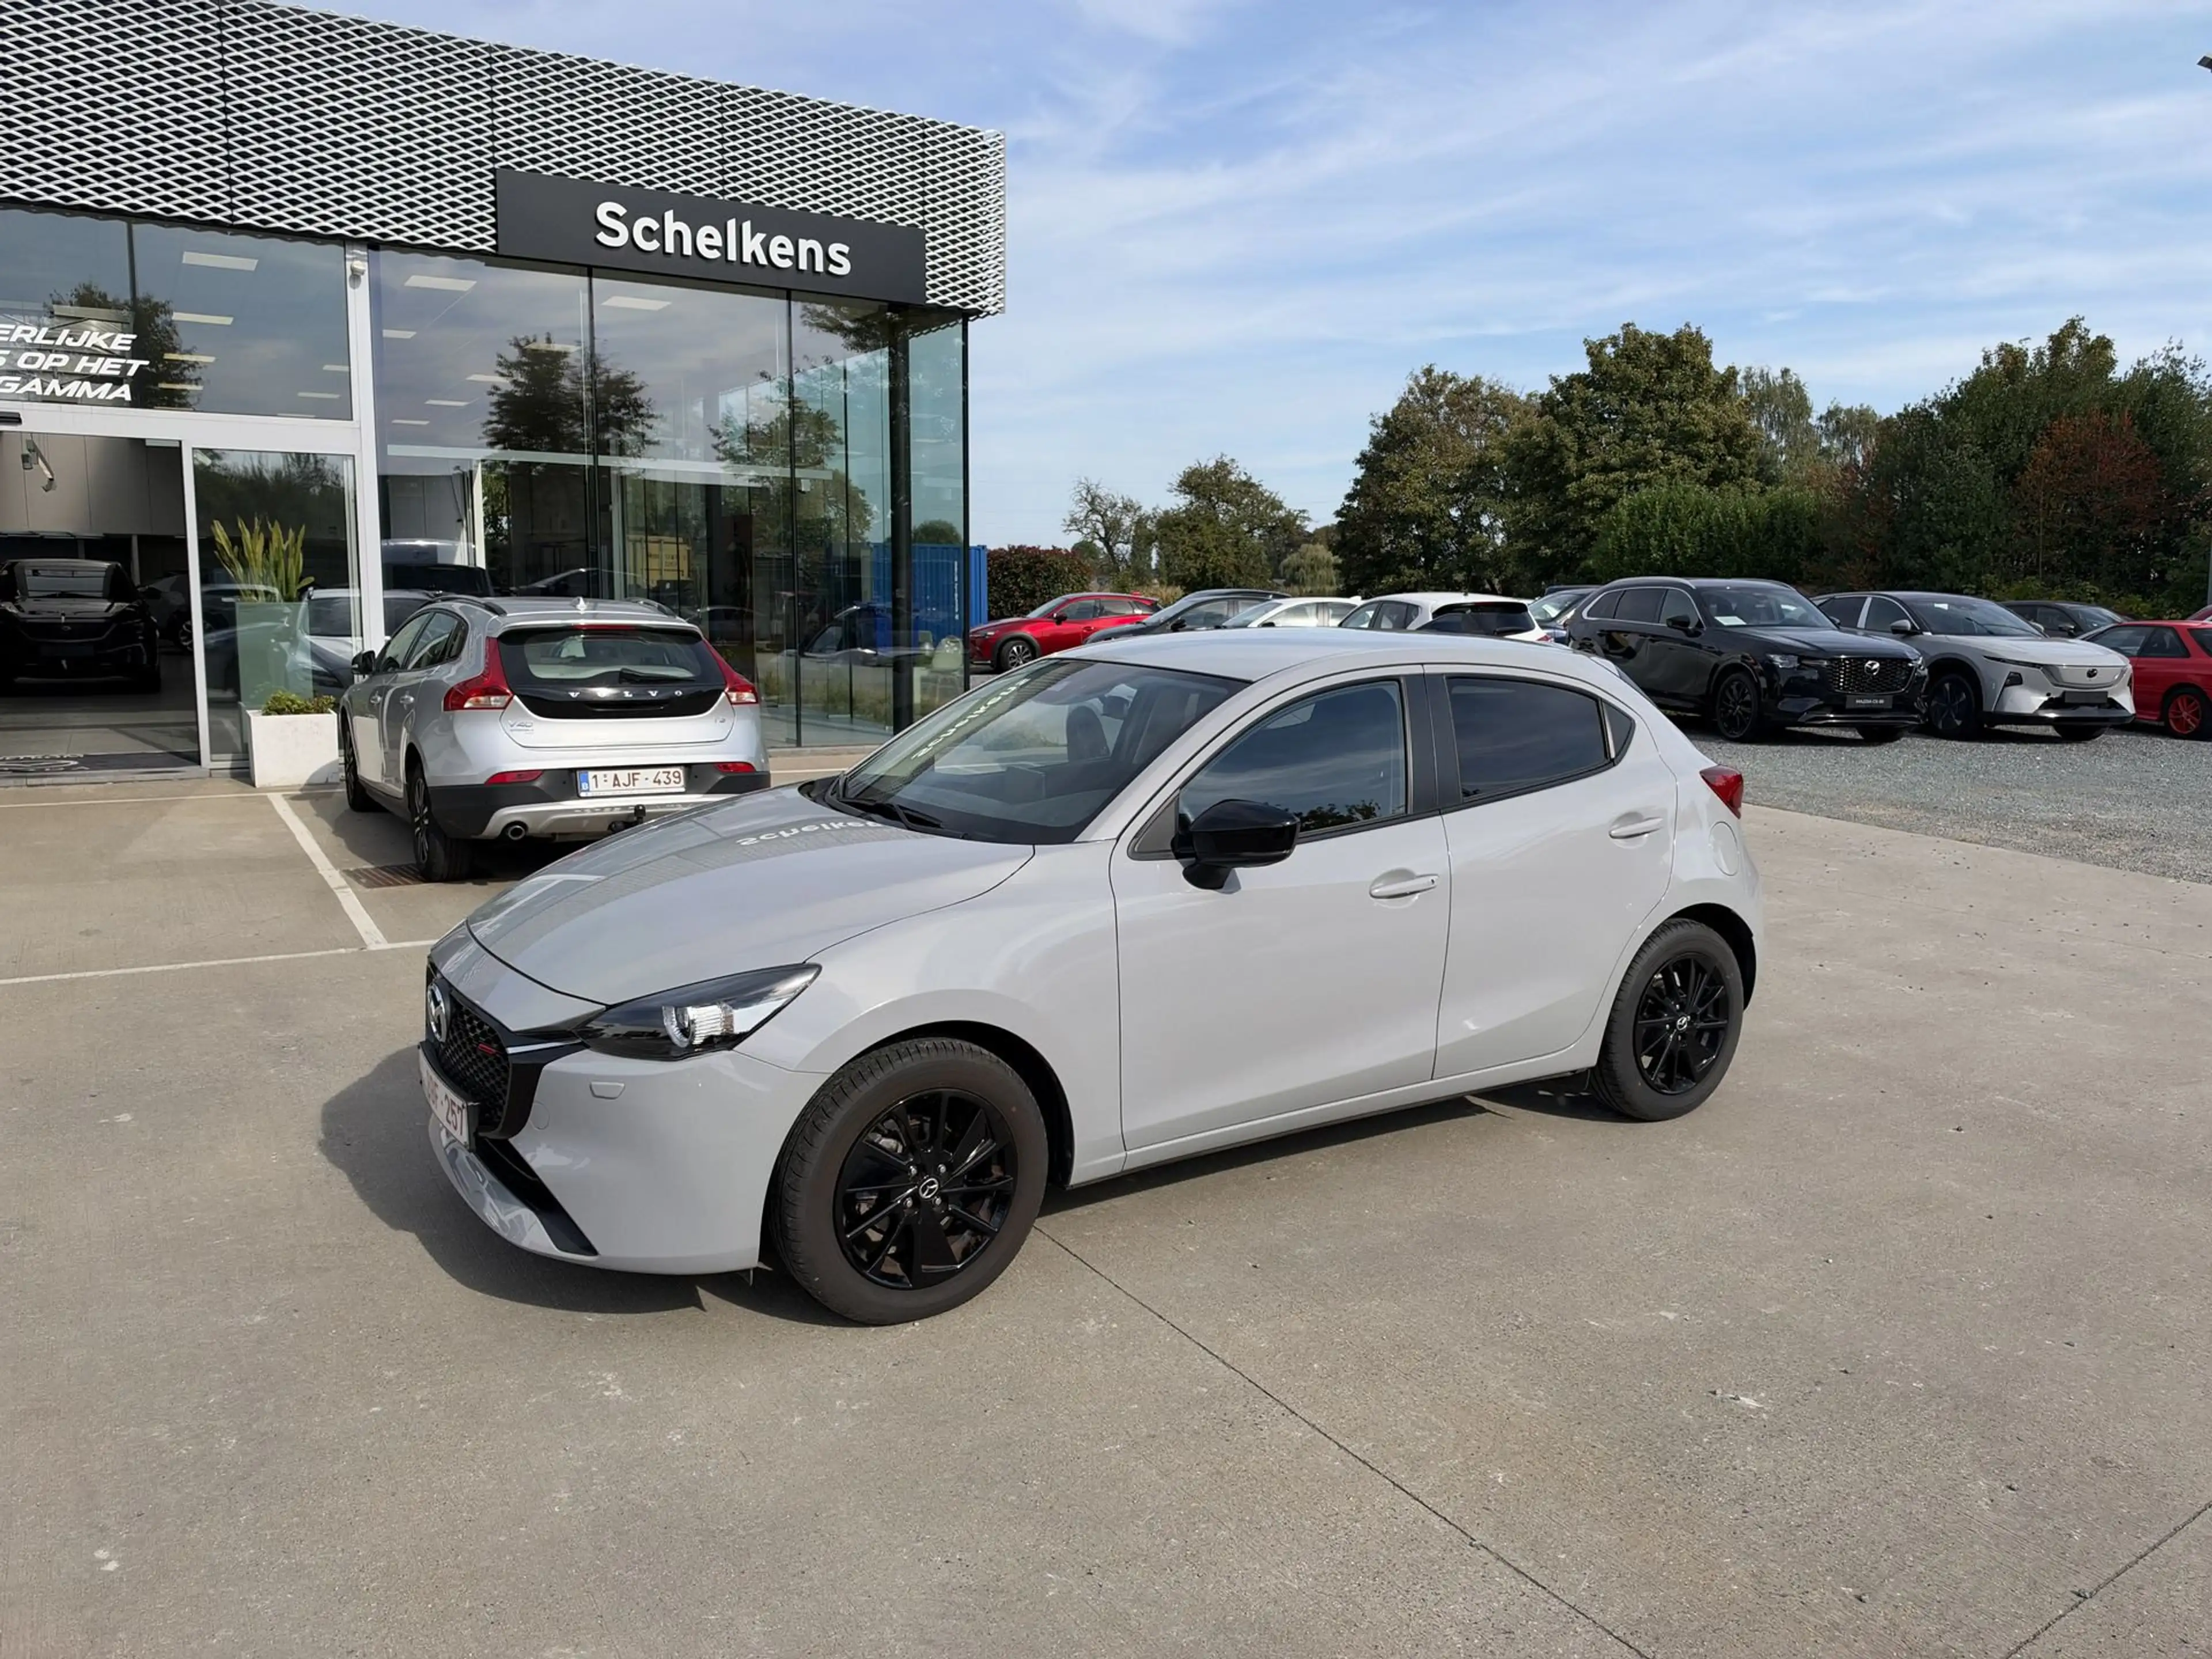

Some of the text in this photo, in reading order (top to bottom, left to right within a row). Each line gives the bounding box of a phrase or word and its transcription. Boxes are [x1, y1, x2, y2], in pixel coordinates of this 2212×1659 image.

[594, 201, 852, 276] Schelkens
[17, 351, 70, 370] OP
[74, 355, 150, 377] HET
[0, 376, 132, 401] GAMMA
